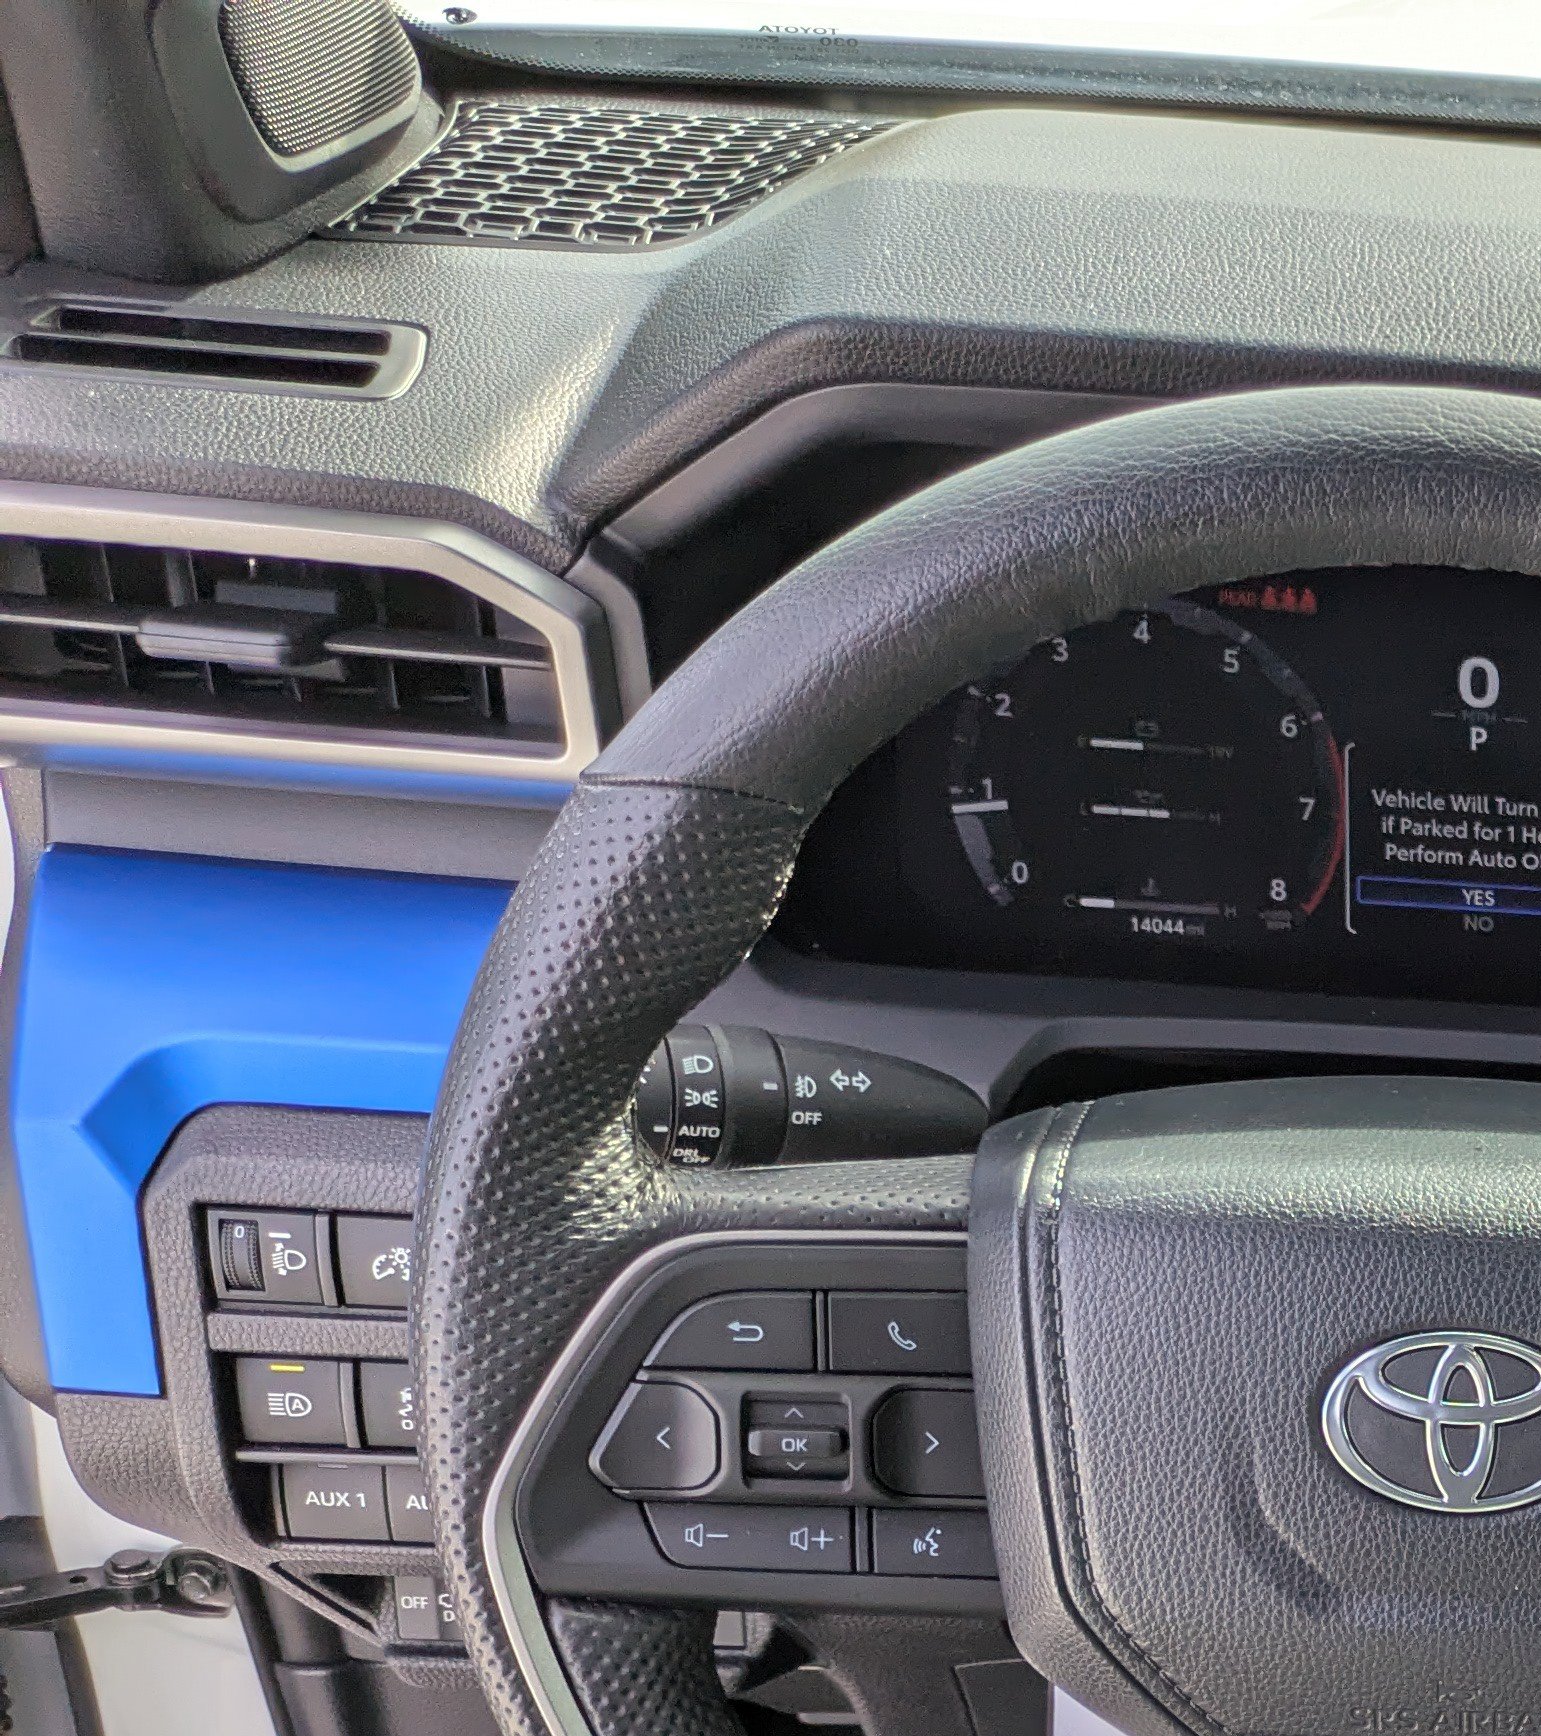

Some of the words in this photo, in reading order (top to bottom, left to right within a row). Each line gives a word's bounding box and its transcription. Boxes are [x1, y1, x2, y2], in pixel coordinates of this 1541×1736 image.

[1134, 620, 1150, 644] 4
[1051, 639, 1070, 663] 3
[1223, 650, 1241, 675] 5
[1458, 656, 1500, 709] 0
[995, 694, 1013, 718] 2
[1281, 714, 1299, 739] 6
[1470, 726, 1488, 751] P
[981, 778, 993, 799] 1
[1299, 796, 1316, 821] 7
[1371, 788, 1445, 811] Vehicle
[1450, 795, 1490, 815] Will
[1495, 798, 1538, 818] Turn
[1381, 816, 1395, 834] if
[1400, 818, 1468, 840] Parked
[1473, 822, 1501, 842] for
[1507, 826, 1515, 843] 1
[1384, 843, 1464, 866] Perform
[1468, 850, 1517, 869] Auto
[1011, 862, 1029, 885] 0
[1270, 878, 1287, 902] 8
[1462, 889, 1496, 907] YES
[1131, 916, 1185, 935] 14044
[1463, 914, 1494, 932] NO
[791, 1111, 823, 1126] OFF
[678, 1125, 720, 1138] AUTO
[782, 1437, 808, 1452] OK
[305, 1490, 349, 1507] AUX
[357, 1492, 367, 1508] 1
[401, 1596, 428, 1609] OFF
[1348, 1706, 1420, 1735] SRS
